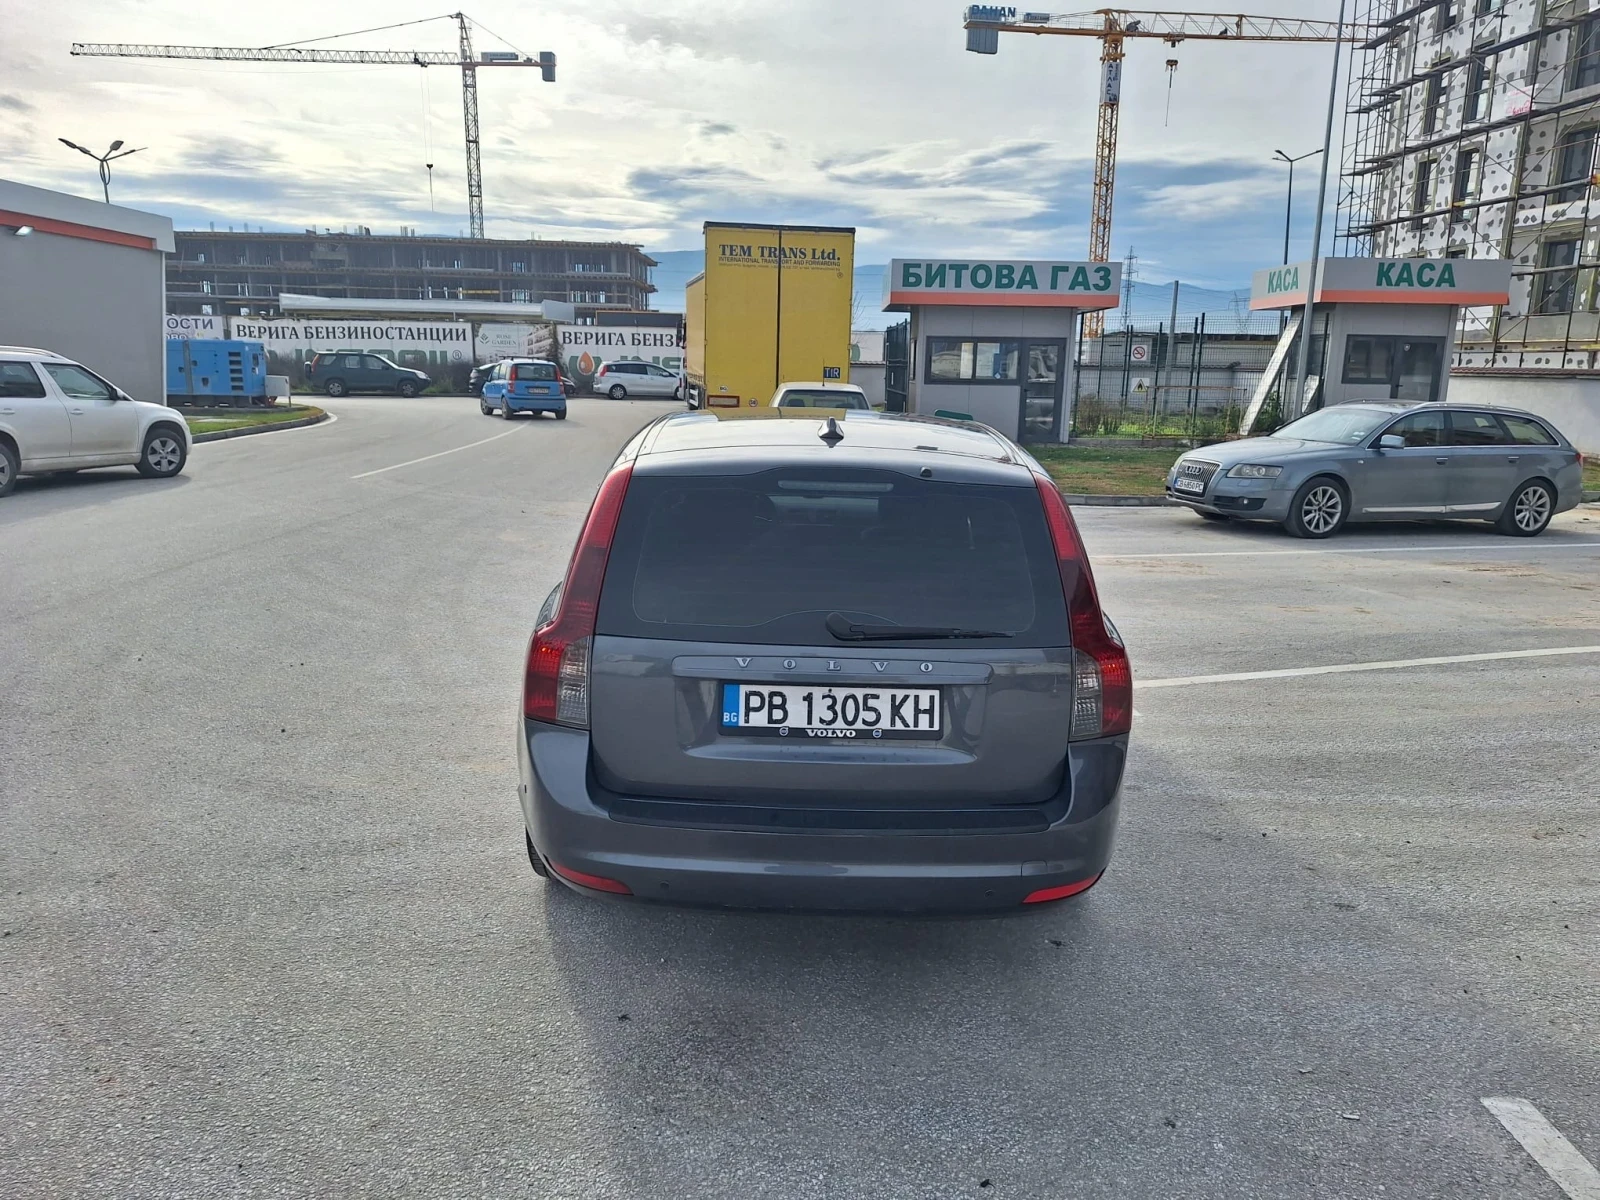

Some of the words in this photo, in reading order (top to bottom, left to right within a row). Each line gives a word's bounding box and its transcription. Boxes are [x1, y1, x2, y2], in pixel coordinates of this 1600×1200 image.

[971, 4, 1016, 18] DAHAN
[718, 256, 760, 264] INTERNATIONAL
[719, 244, 752, 257] TEM
[758, 246, 807, 260] TRANS
[811, 248, 841, 261] Ltd.
[902, 263, 1039, 290] БИТОВА
[1050, 265, 1112, 291] ГАЗ
[1267, 266, 1299, 294] КАСА
[1376, 262, 1456, 288] КАСА
[167, 317, 214, 330] ОСТИ
[236, 324, 300, 340] ВЕРИГА
[304, 325, 467, 344] БЕНЗИНОСТАНЦИИ
[561, 331, 626, 346] ВЕРИГА
[824, 367, 840, 378] TIR
[734, 657, 934, 673] VOLVO
[723, 712, 738, 723] BG
[744, 690, 789, 725] PB
[802, 691, 882, 728] 1305
[890, 693, 936, 729] KH
[805, 728, 857, 738] VOLVO
